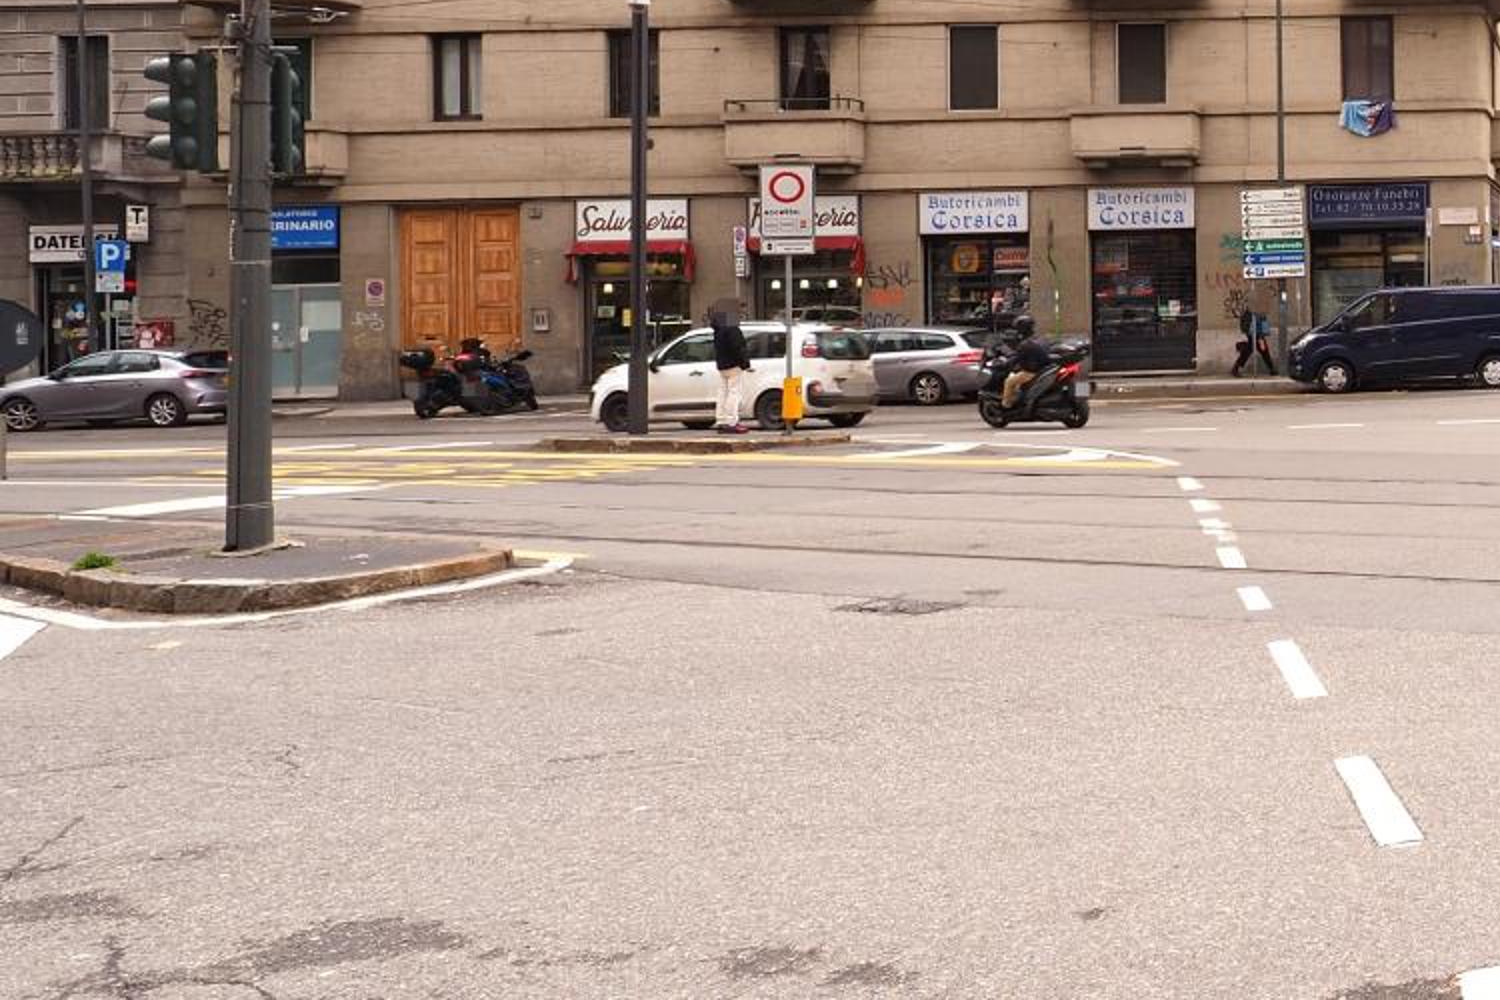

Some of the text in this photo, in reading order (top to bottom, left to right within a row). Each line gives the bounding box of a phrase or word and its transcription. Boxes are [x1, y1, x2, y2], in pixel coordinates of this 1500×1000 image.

[928, 195, 1020, 208] Autoricambi
[1096, 191, 1187, 205] Autoricambi
[931, 211, 1018, 229] Corsica
[1100, 206, 1185, 225] Corsica
[101, 243, 120, 269] P
